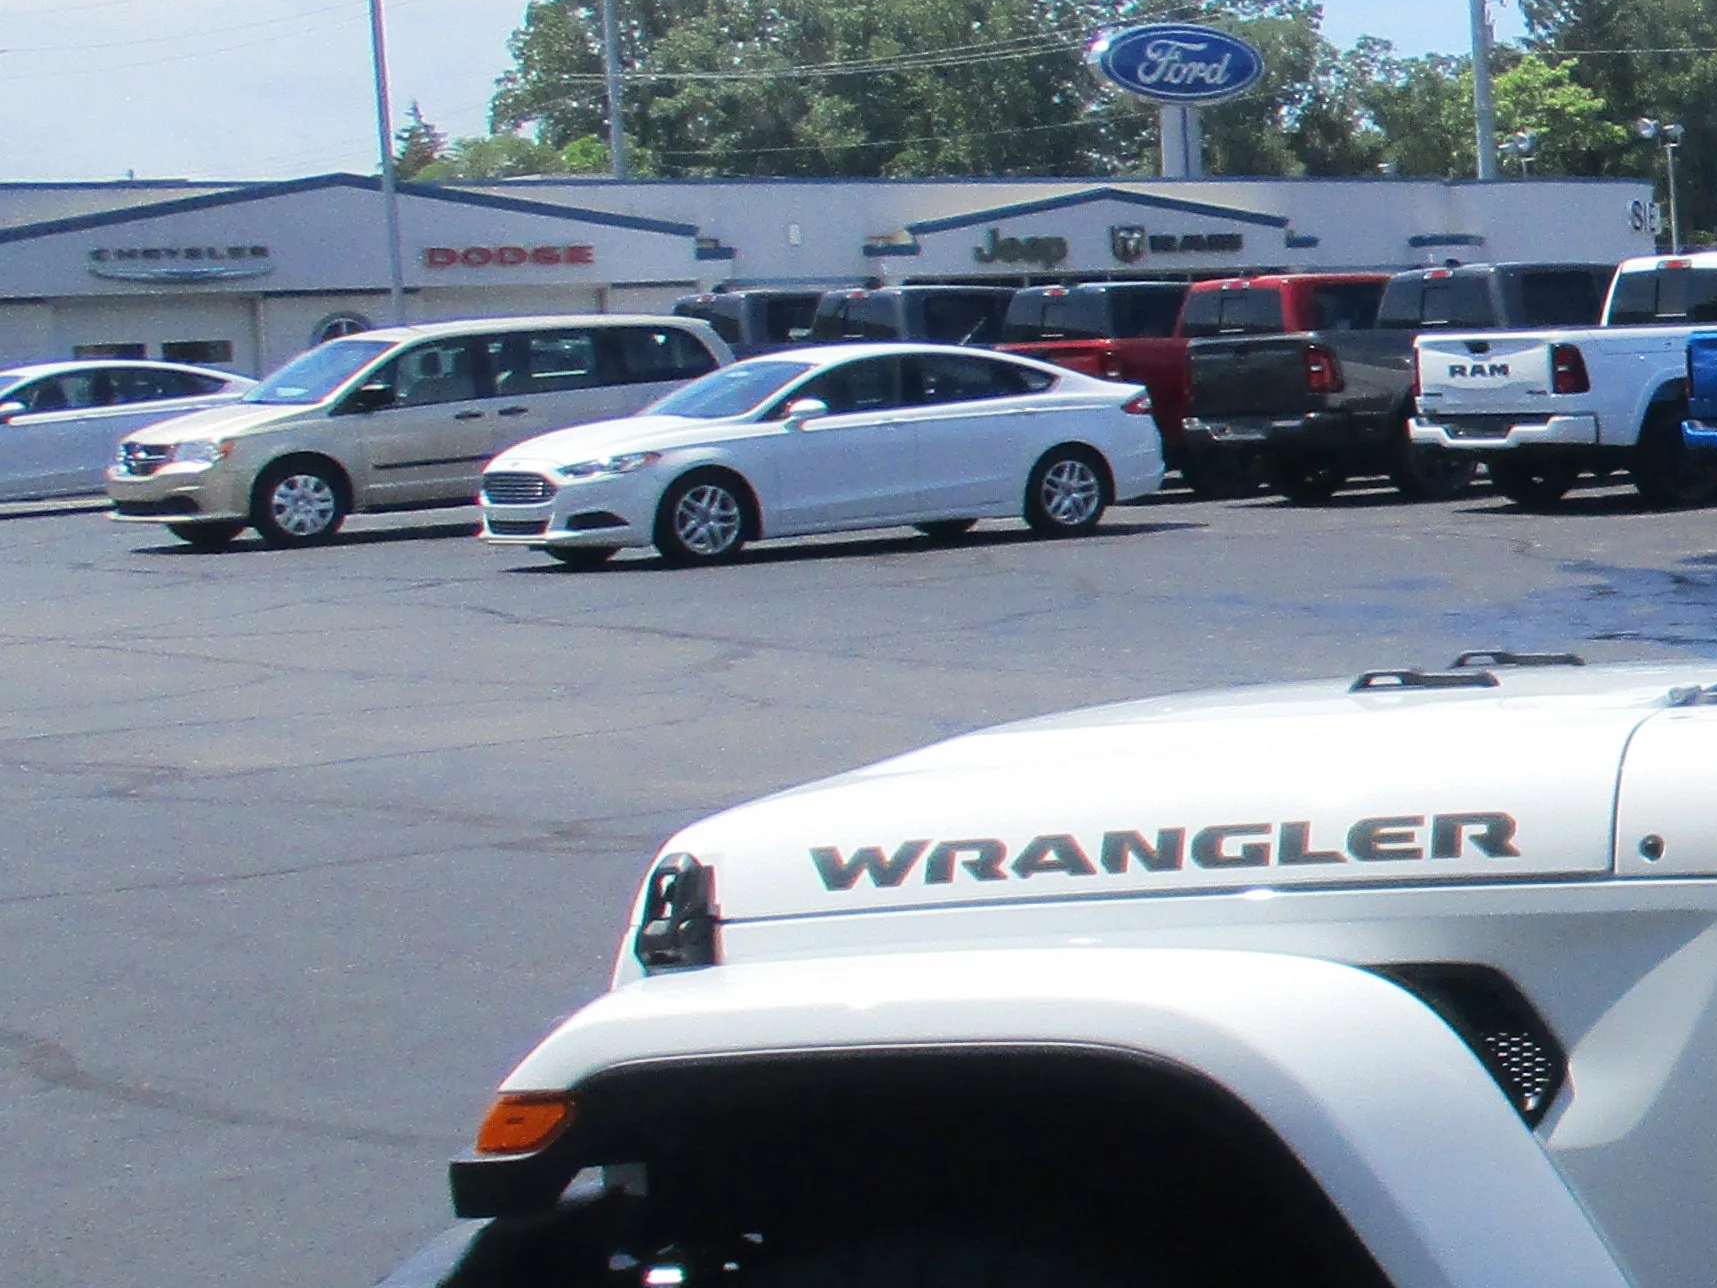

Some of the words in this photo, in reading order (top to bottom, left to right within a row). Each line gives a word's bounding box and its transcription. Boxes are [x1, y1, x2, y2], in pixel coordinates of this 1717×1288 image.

[1137, 39, 1232, 85] Ford
[426, 245, 596, 268] DODGE
[1449, 363, 1510, 378] RAM
[809, 811, 1522, 893] WRANGLER
